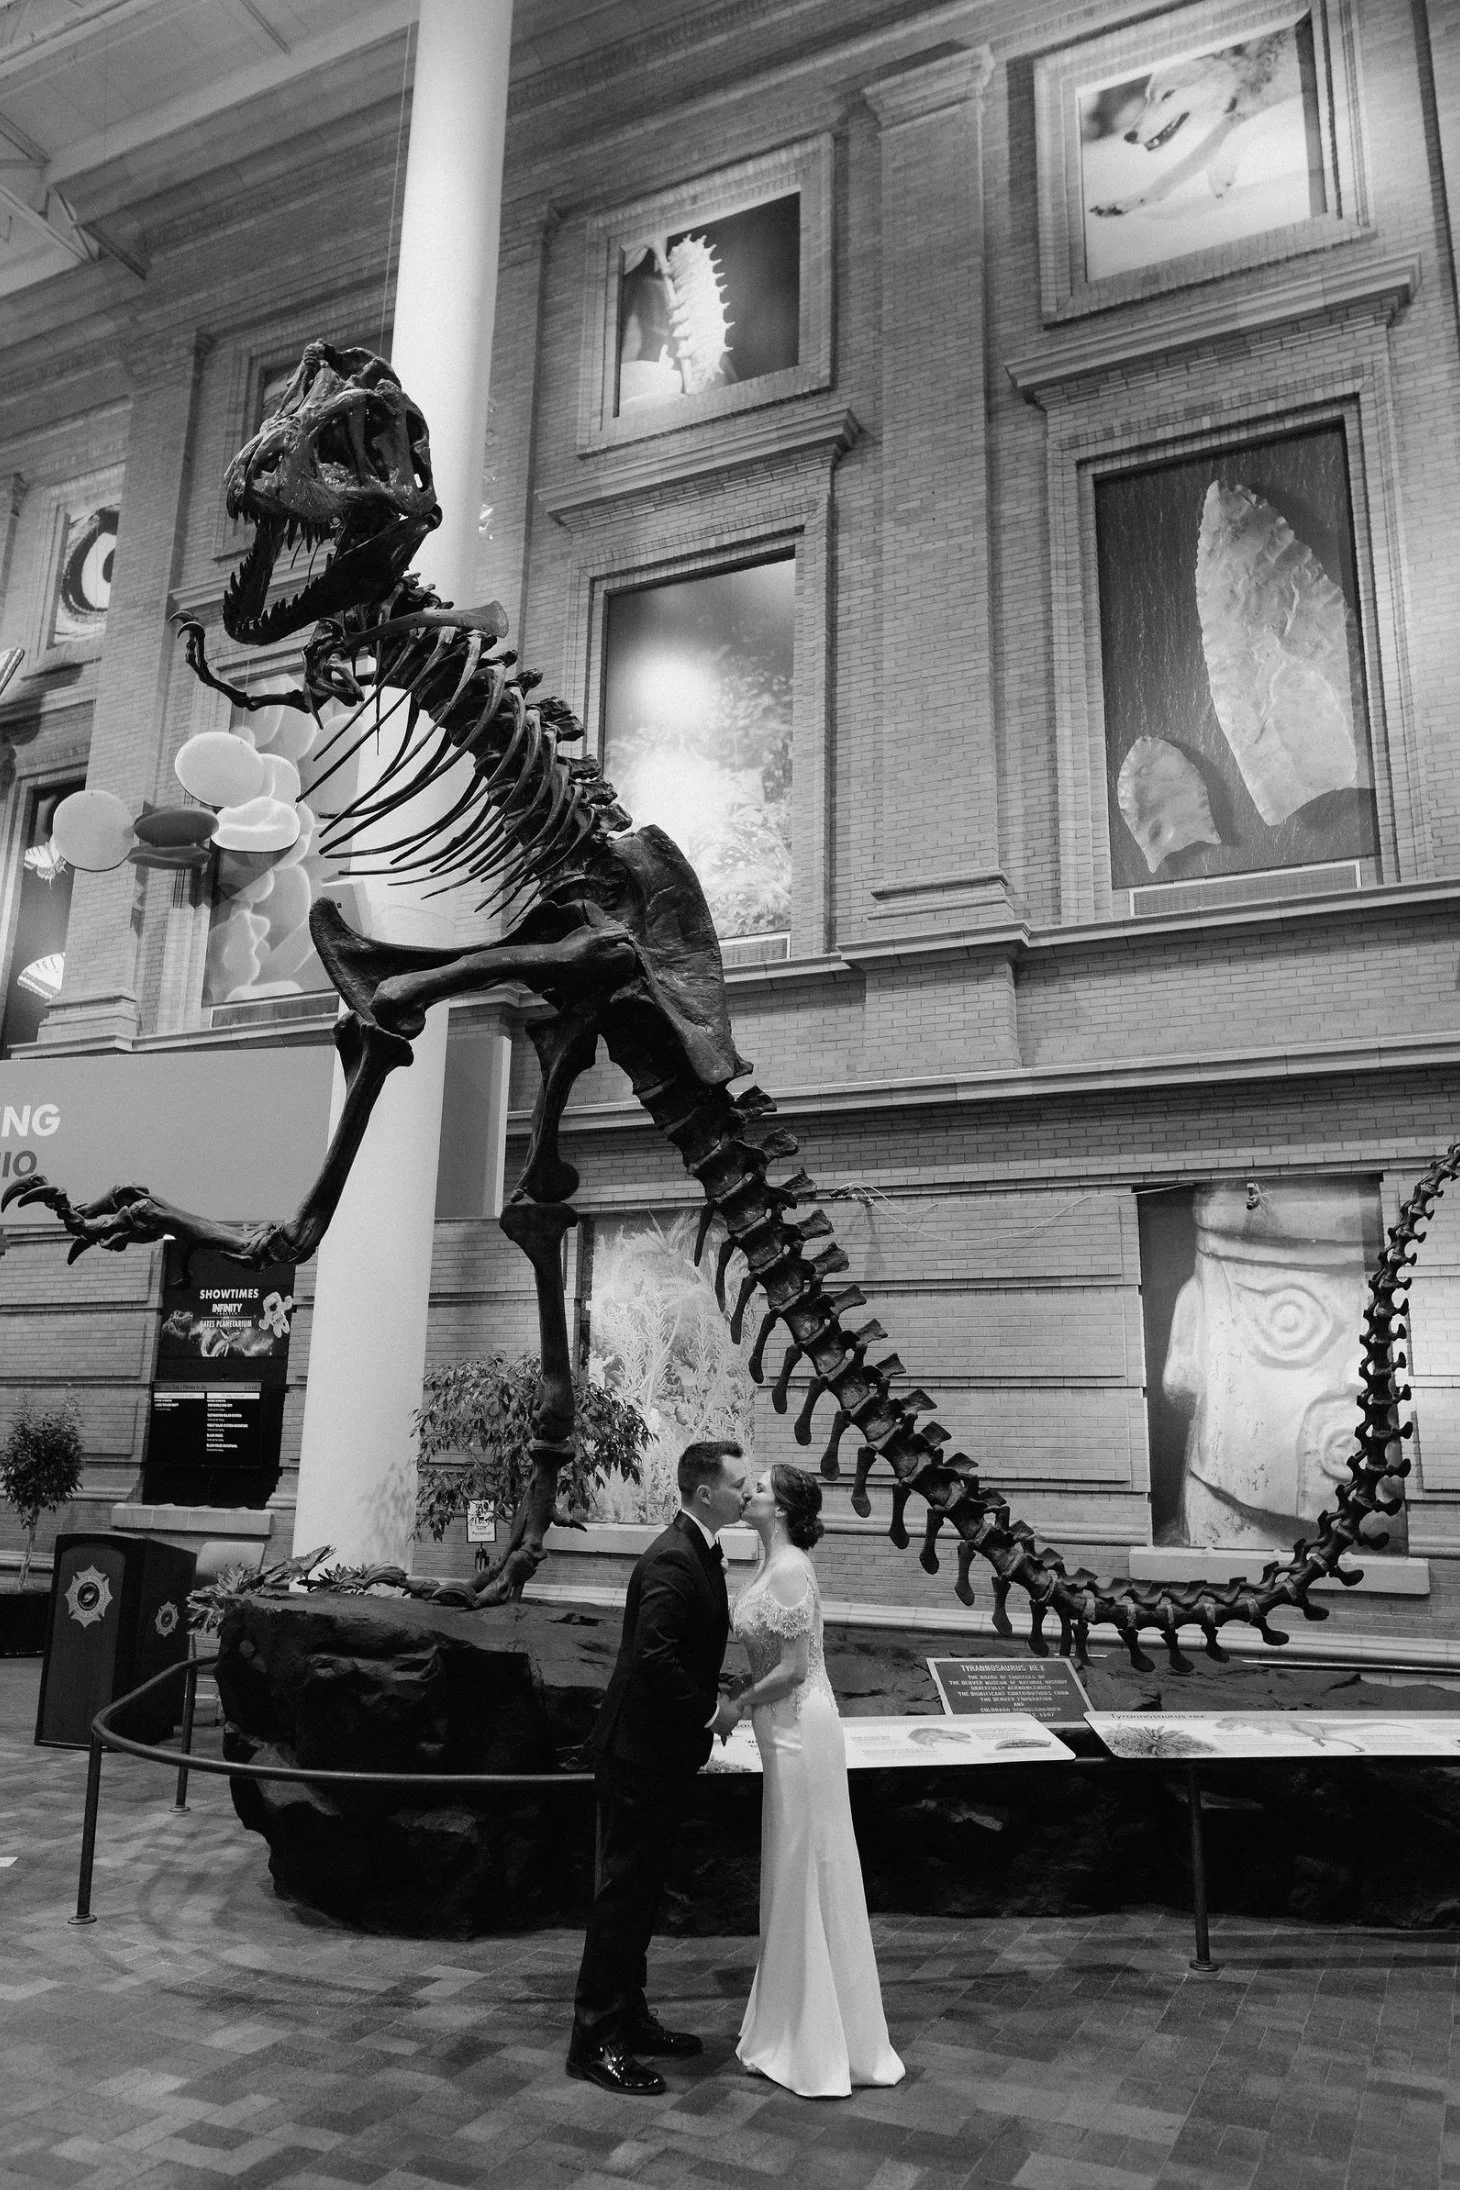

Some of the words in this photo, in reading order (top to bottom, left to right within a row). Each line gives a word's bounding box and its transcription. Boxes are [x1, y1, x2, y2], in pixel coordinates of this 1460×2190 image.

[0, 1103, 61, 1138] NG
[0, 1150, 37, 1178] IO
[199, 1288, 260, 1300] SHOWTIMES
[211, 1303, 243, 1313] INFINITY
[215, 1319, 253, 1328] PLANETARIUM
[960, 1664, 1027, 1672] TYRANNOSAURUS
[1028, 1664, 1046, 1672] REX
